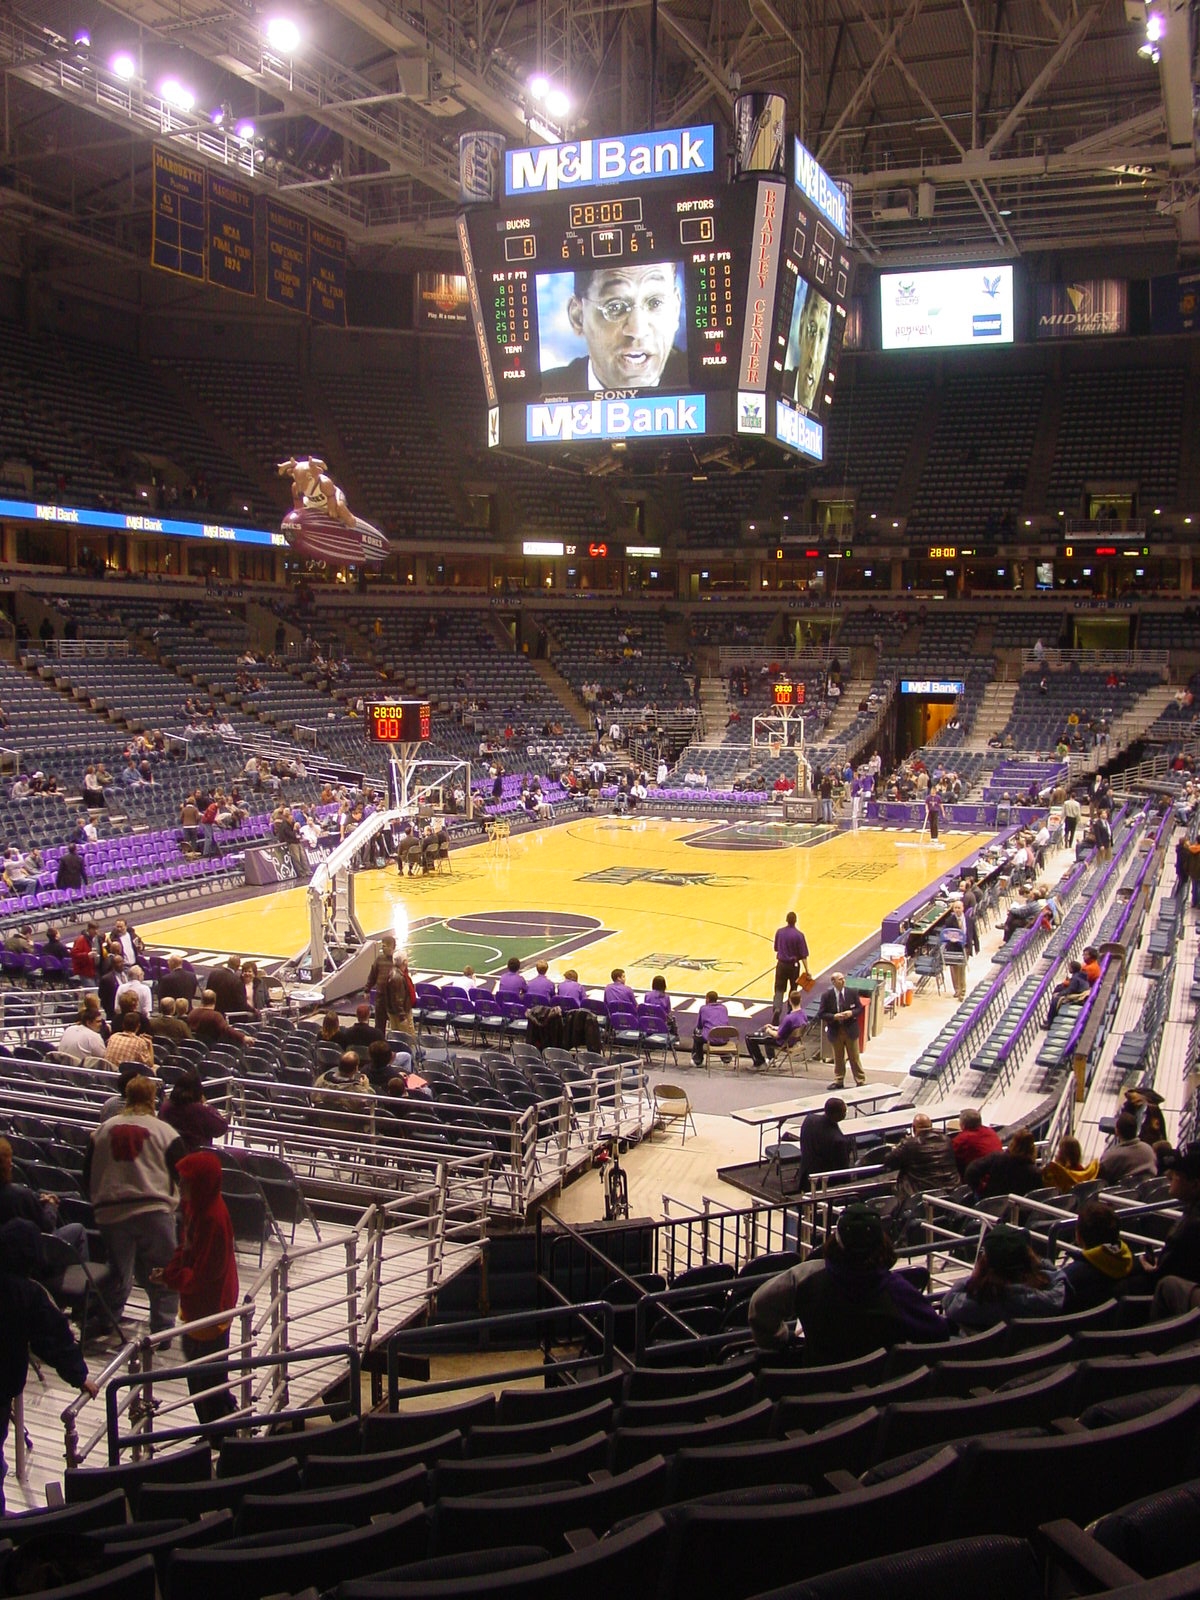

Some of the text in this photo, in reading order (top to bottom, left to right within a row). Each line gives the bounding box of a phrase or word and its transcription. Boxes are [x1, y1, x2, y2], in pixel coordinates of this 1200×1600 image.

[512, 132, 705, 190] M&I Bank
[676, 200, 714, 212] RAPTORS
[820, 170, 845, 234] Bank
[573, 203, 622, 225] 28:00
[506, 219, 530, 230] BUCKS
[701, 220, 710, 239] 0
[757, 190, 776, 288] BRADLEY
[524, 239, 533, 256] 0
[631, 239, 638, 252] 6
[562, 246, 569, 258] 6
[693, 252, 731, 263] PLR F PTS
[493, 273, 504, 281] PLR
[515, 272, 528, 280] PTS
[500, 286, 505, 294] 8
[700, 280, 707, 289] 5
[495, 299, 505, 307] 22
[495, 311, 506, 319] 24
[695, 306, 707, 315] 24
[696, 318, 708, 328] 55
[1039, 310, 1121, 326] MIDWEST
[496, 322, 507, 331] 25
[1074, 320, 1121, 332] AIRLINES
[497, 334, 507, 343] 50
[704, 331, 724, 339] TEAM
[746, 299, 766, 384] CENTER
[504, 346, 522, 354] TEAM
[703, 356, 727, 365] FOULS
[503, 370, 526, 379] FOULS
[594, 390, 639, 401] SONY
[532, 399, 698, 440] M&I Bank
[798, 415, 821, 456] Bank
[36, 505, 79, 522] M&I Bank
[143, 517, 163, 531] Bank
[218, 527, 236, 540] Bank
[930, 547, 956, 558] 28:00
[1066, 547, 1072, 557] 0
[775, 685, 793, 693] 28:00
[931, 682, 958, 694] Bank
[777, 692, 790, 703] 00
[374, 706, 402, 719] 28:00
[378, 718, 399, 739] 00
